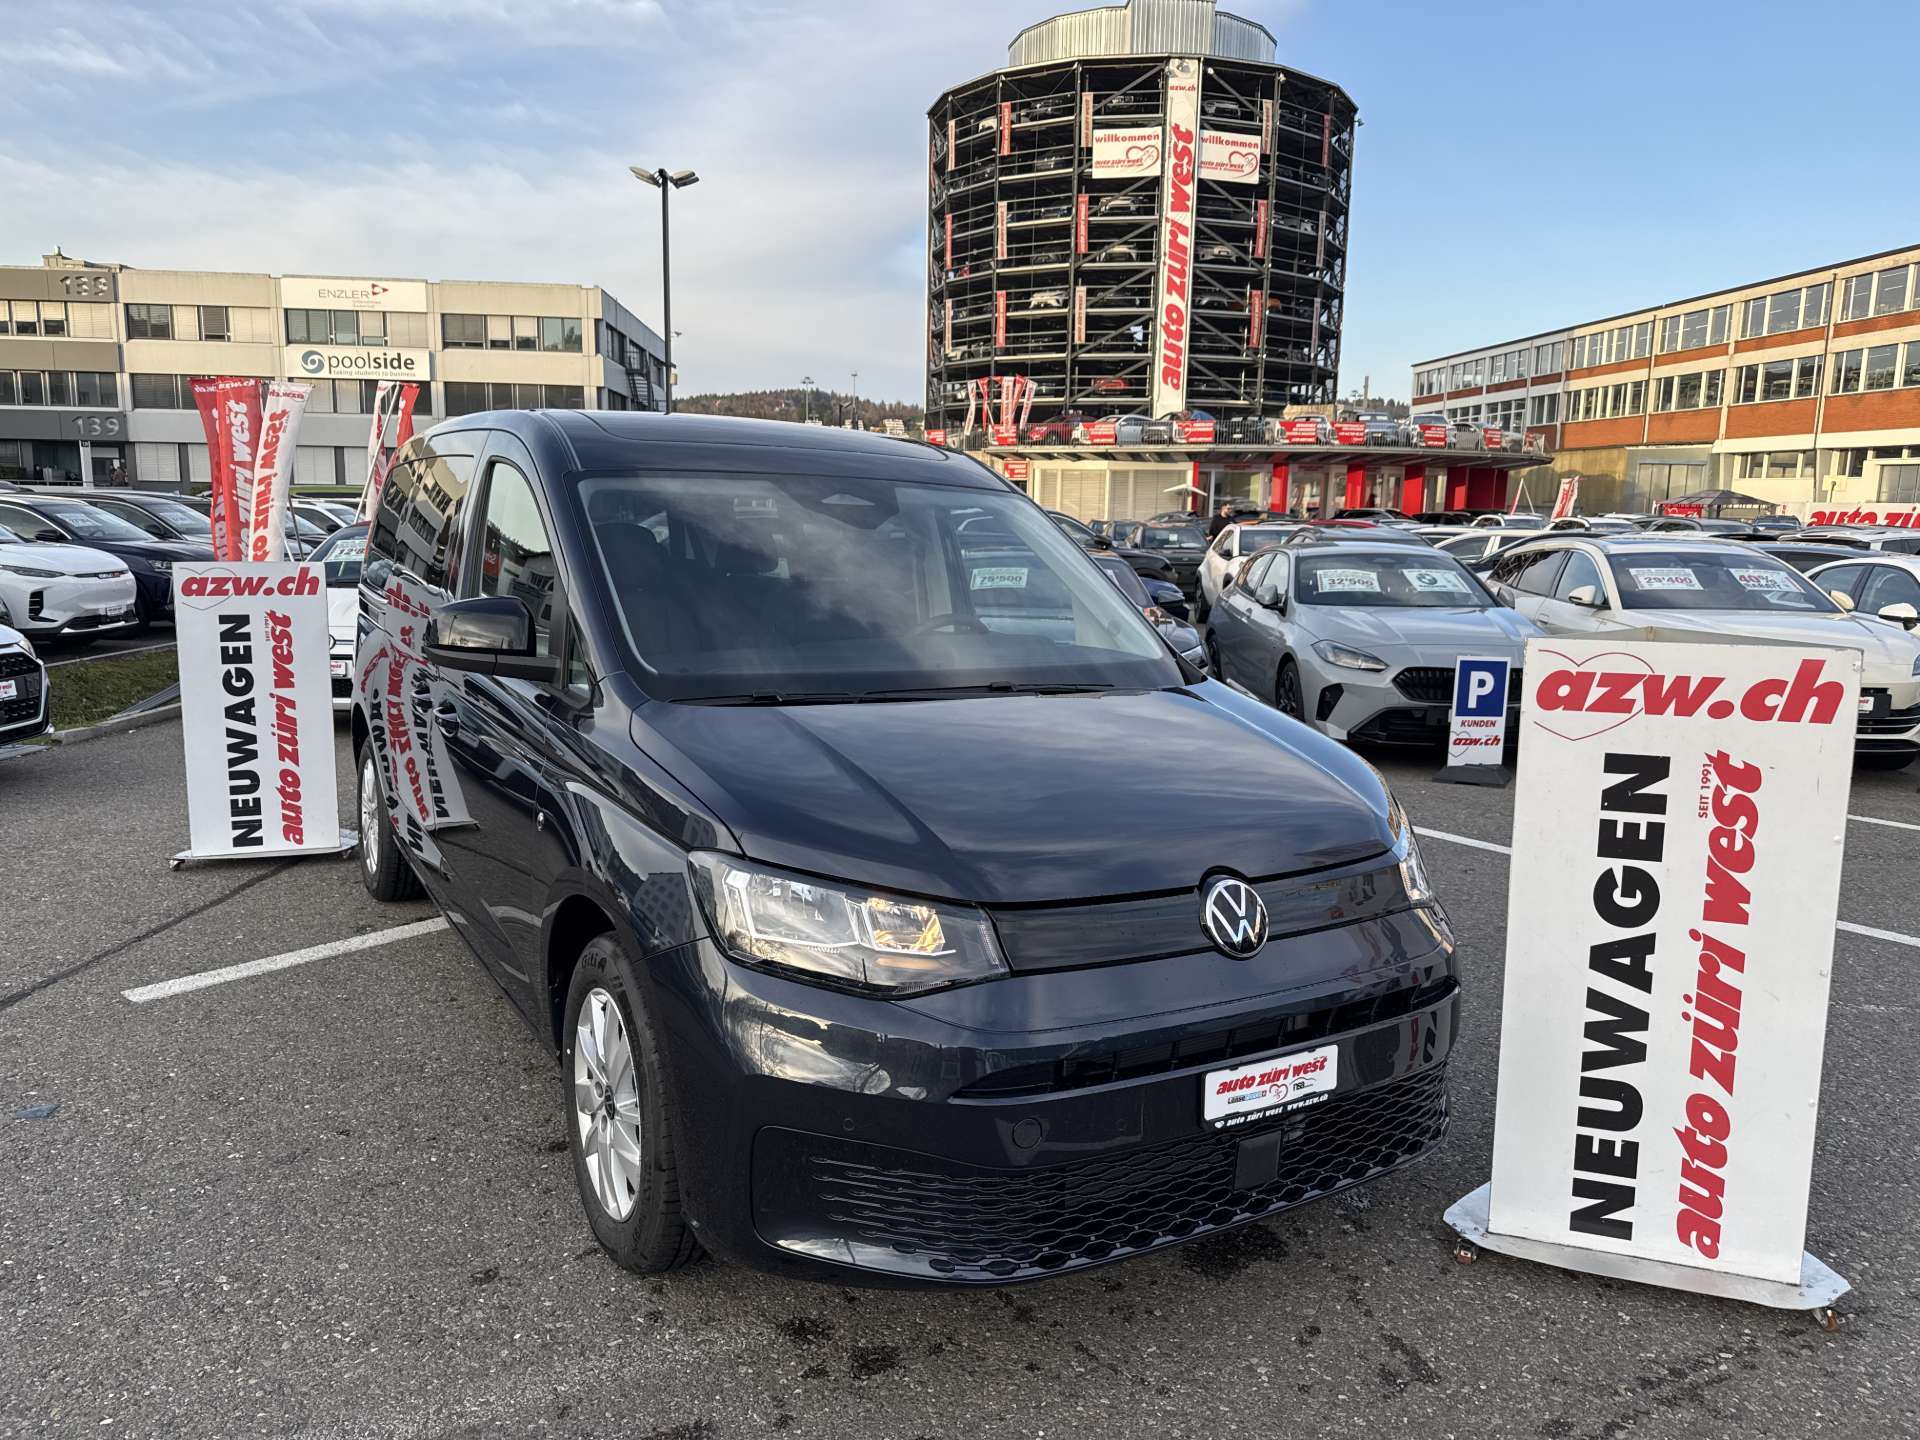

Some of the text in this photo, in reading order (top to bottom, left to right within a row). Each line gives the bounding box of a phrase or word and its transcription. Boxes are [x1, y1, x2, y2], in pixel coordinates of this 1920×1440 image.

[1168, 84, 1196, 92] azw.ch
[1095, 133, 1160, 144] willkommen
[1200, 135, 1259, 149] willkommen
[1161, 122, 1194, 391] auto züri west
[318, 288, 371, 299] ENZLER
[328, 351, 415, 375] poolside
[390, 370, 416, 378] business
[72, 416, 120, 436] 139
[225, 400, 251, 462] west
[1807, 506, 1877, 527] auto
[181, 566, 320, 597] azw.ch
[1467, 670, 1495, 709] P
[1535, 658, 1845, 725] azw.ch
[218, 614, 264, 848] NEUWAGEN
[264, 609, 304, 845] auto züri west
[1460, 719, 1497, 728] KUNDEN
[1452, 734, 1502, 747] azw.ch
[1697, 762, 1713, 819] SEIT 1991
[1569, 752, 1672, 1242] NEUWAGEN
[1672, 749, 1763, 1260] auto züri west
[1216, 1055, 1329, 1096] auto züri west
[1226, 1116, 1246, 1127] auto
[1265, 1105, 1284, 1117] west
